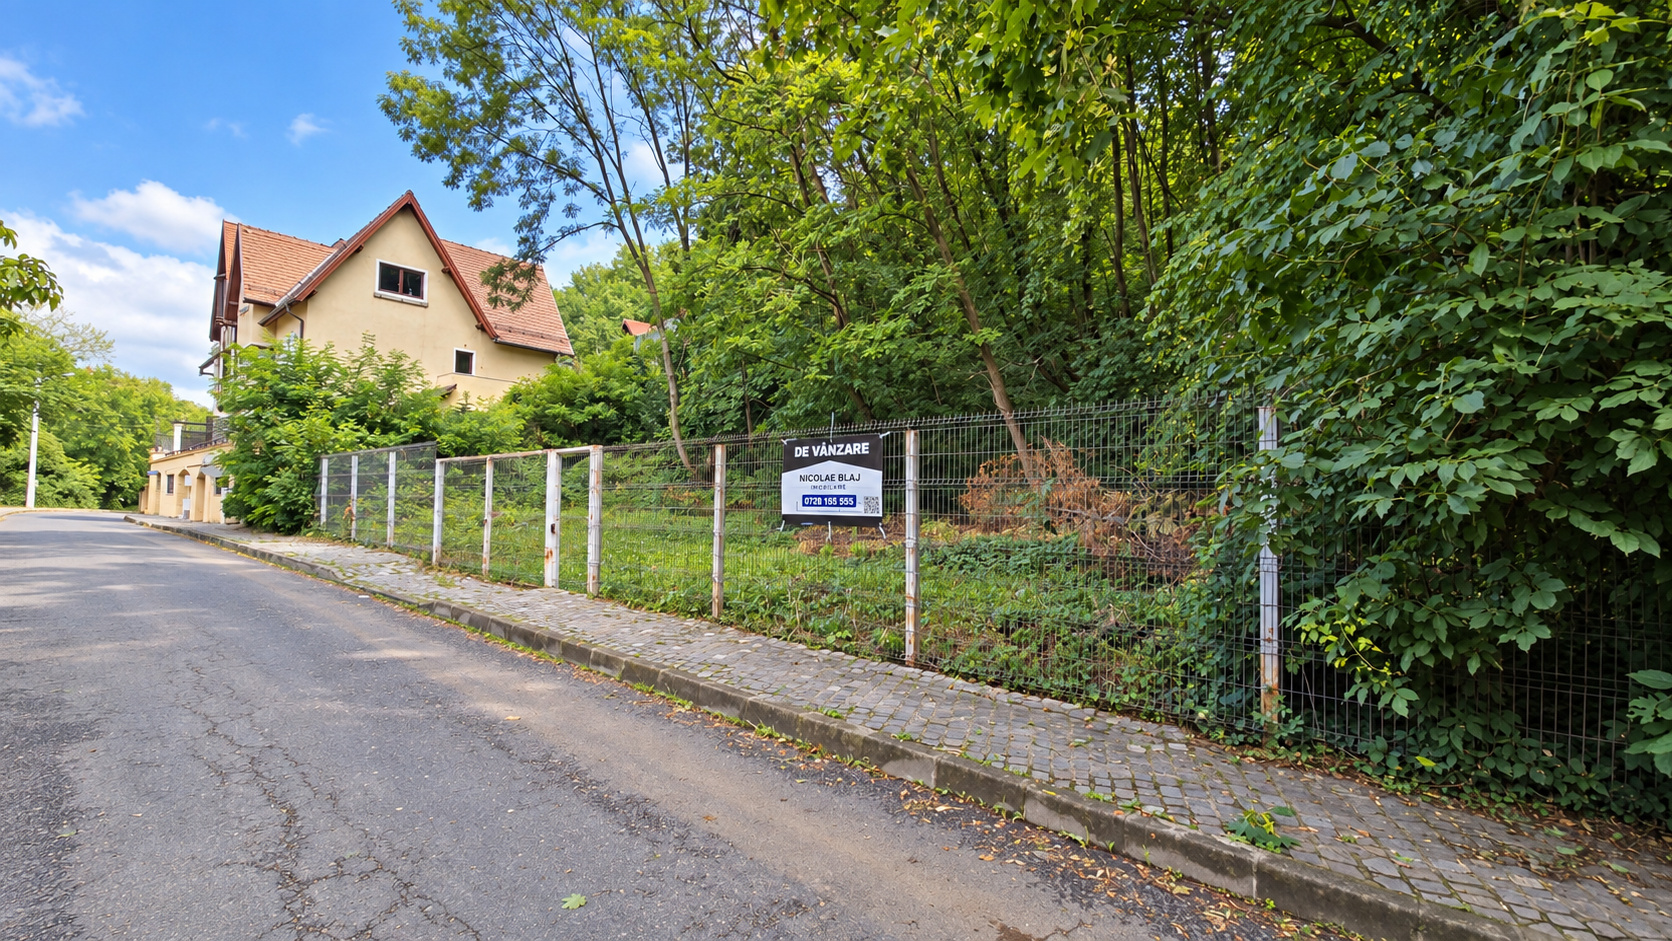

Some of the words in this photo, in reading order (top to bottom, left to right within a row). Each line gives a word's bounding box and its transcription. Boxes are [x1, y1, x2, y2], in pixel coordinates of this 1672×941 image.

[794, 446, 809, 457] DE
[800, 474, 835, 482] NICOLAE
[838, 473, 861, 482] BLAJ
